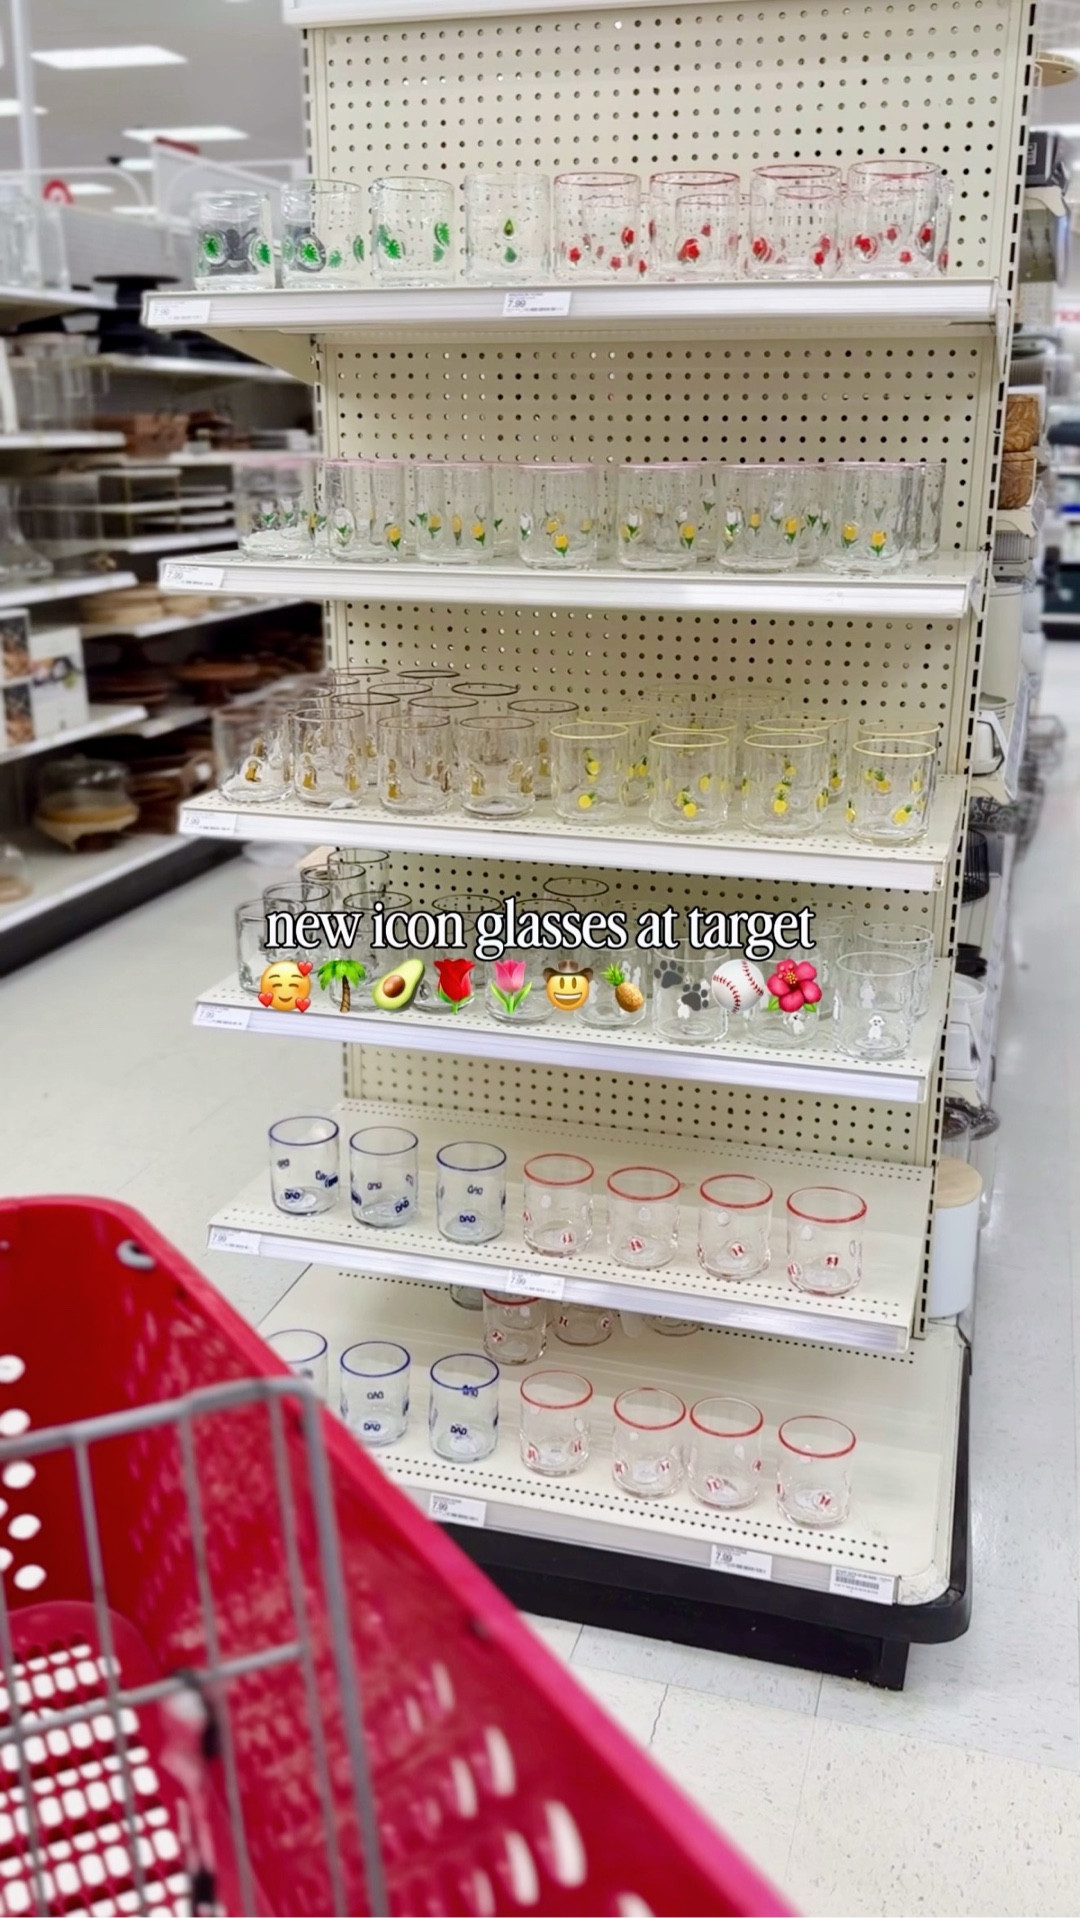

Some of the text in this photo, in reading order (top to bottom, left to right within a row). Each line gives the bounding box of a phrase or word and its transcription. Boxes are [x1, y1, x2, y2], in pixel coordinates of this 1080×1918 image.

[459, 1215, 476, 1223] DAD
[363, 1422, 381, 1432] DAD
[450, 1425, 468, 1436] DAD
